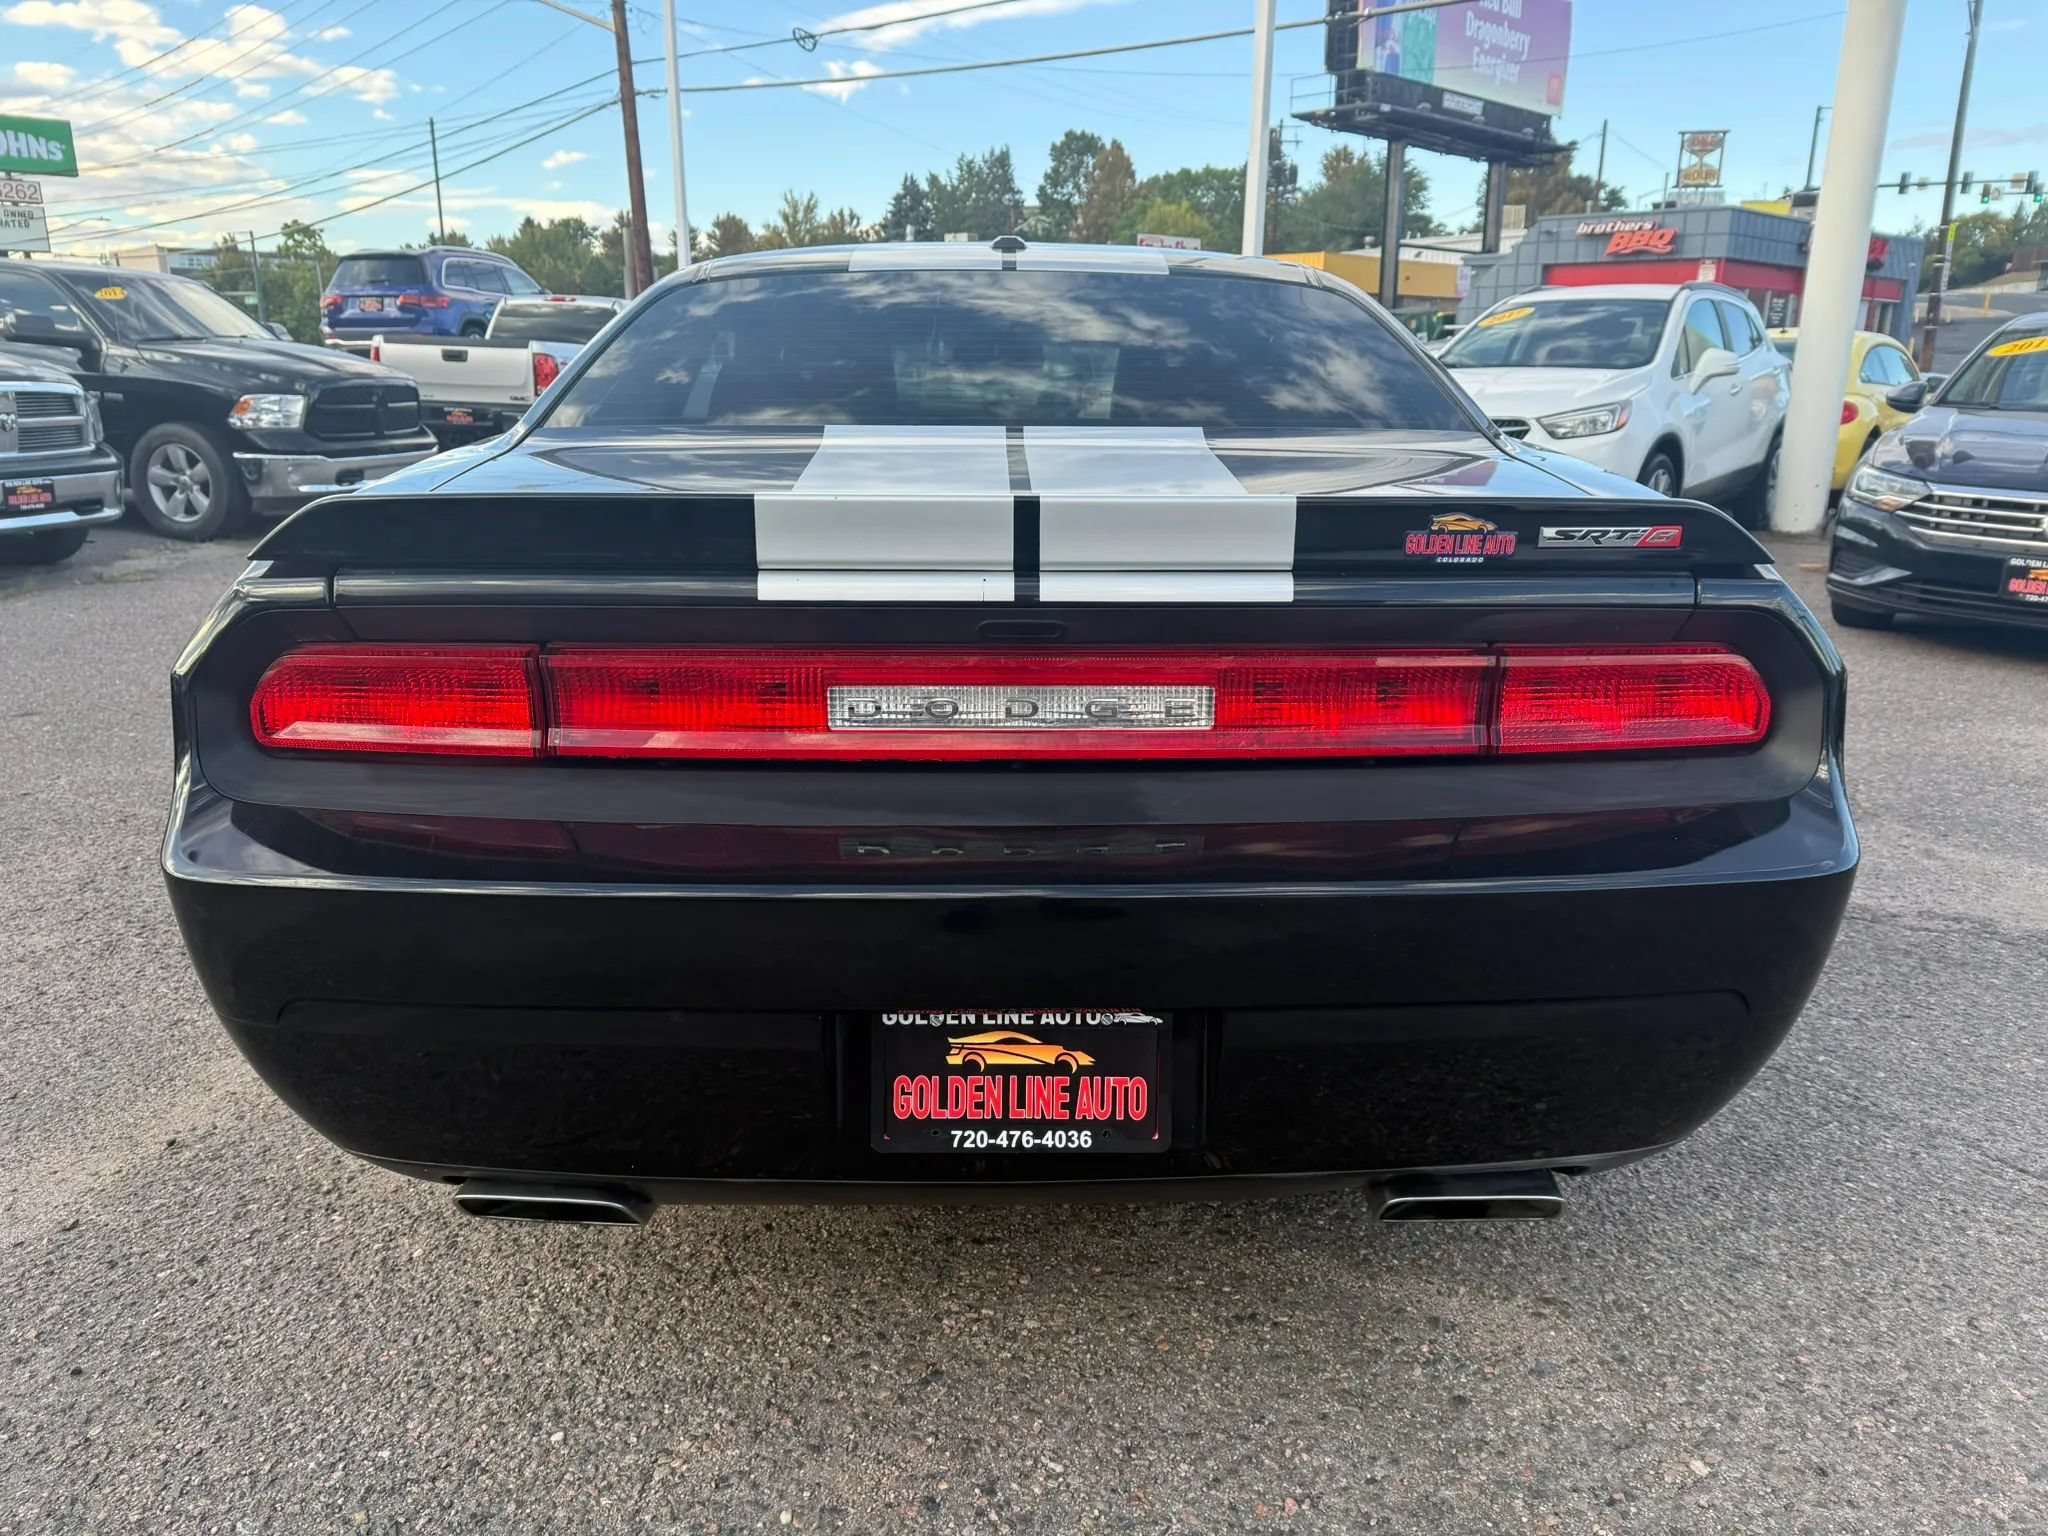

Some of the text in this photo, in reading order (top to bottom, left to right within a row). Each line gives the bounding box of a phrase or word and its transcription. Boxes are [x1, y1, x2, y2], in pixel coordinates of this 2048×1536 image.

[1466, 10, 1531, 61] Dragonberry
[1472, 47, 1521, 84] Energizer
[1684, 168, 1718, 182] HOUR
[0, 183, 39, 201] 262
[3, 209, 34, 220] OWNED
[1576, 220, 1656, 236] brothers
[1605, 227, 1680, 256] BBQ
[1406, 534, 1516, 555] GOLDEN LINE AUTO
[847, 697, 1197, 718] DODGE
[893, 1074, 1148, 1120] GOLDEN LINE AUTO
[951, 1130, 1093, 1148] 720-476-4036
